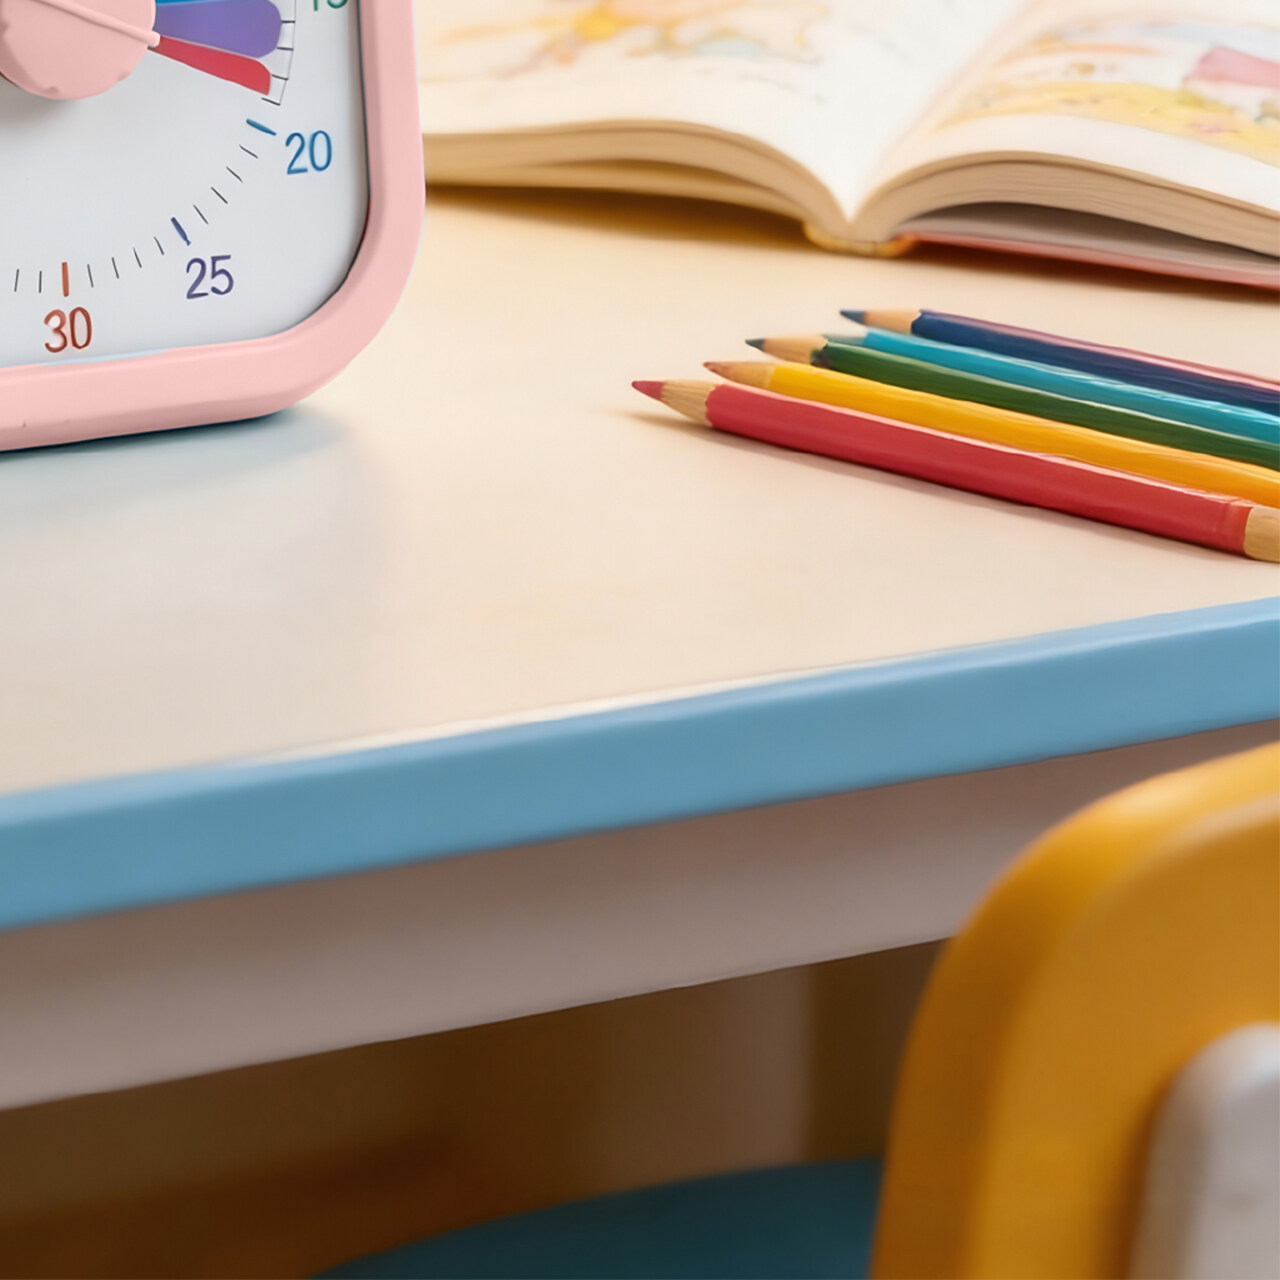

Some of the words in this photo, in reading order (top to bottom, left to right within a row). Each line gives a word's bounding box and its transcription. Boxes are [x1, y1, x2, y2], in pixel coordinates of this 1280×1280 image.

[286, 130, 332, 175] 20
[187, 256, 233, 298] 25
[44, 307, 92, 353] 30
